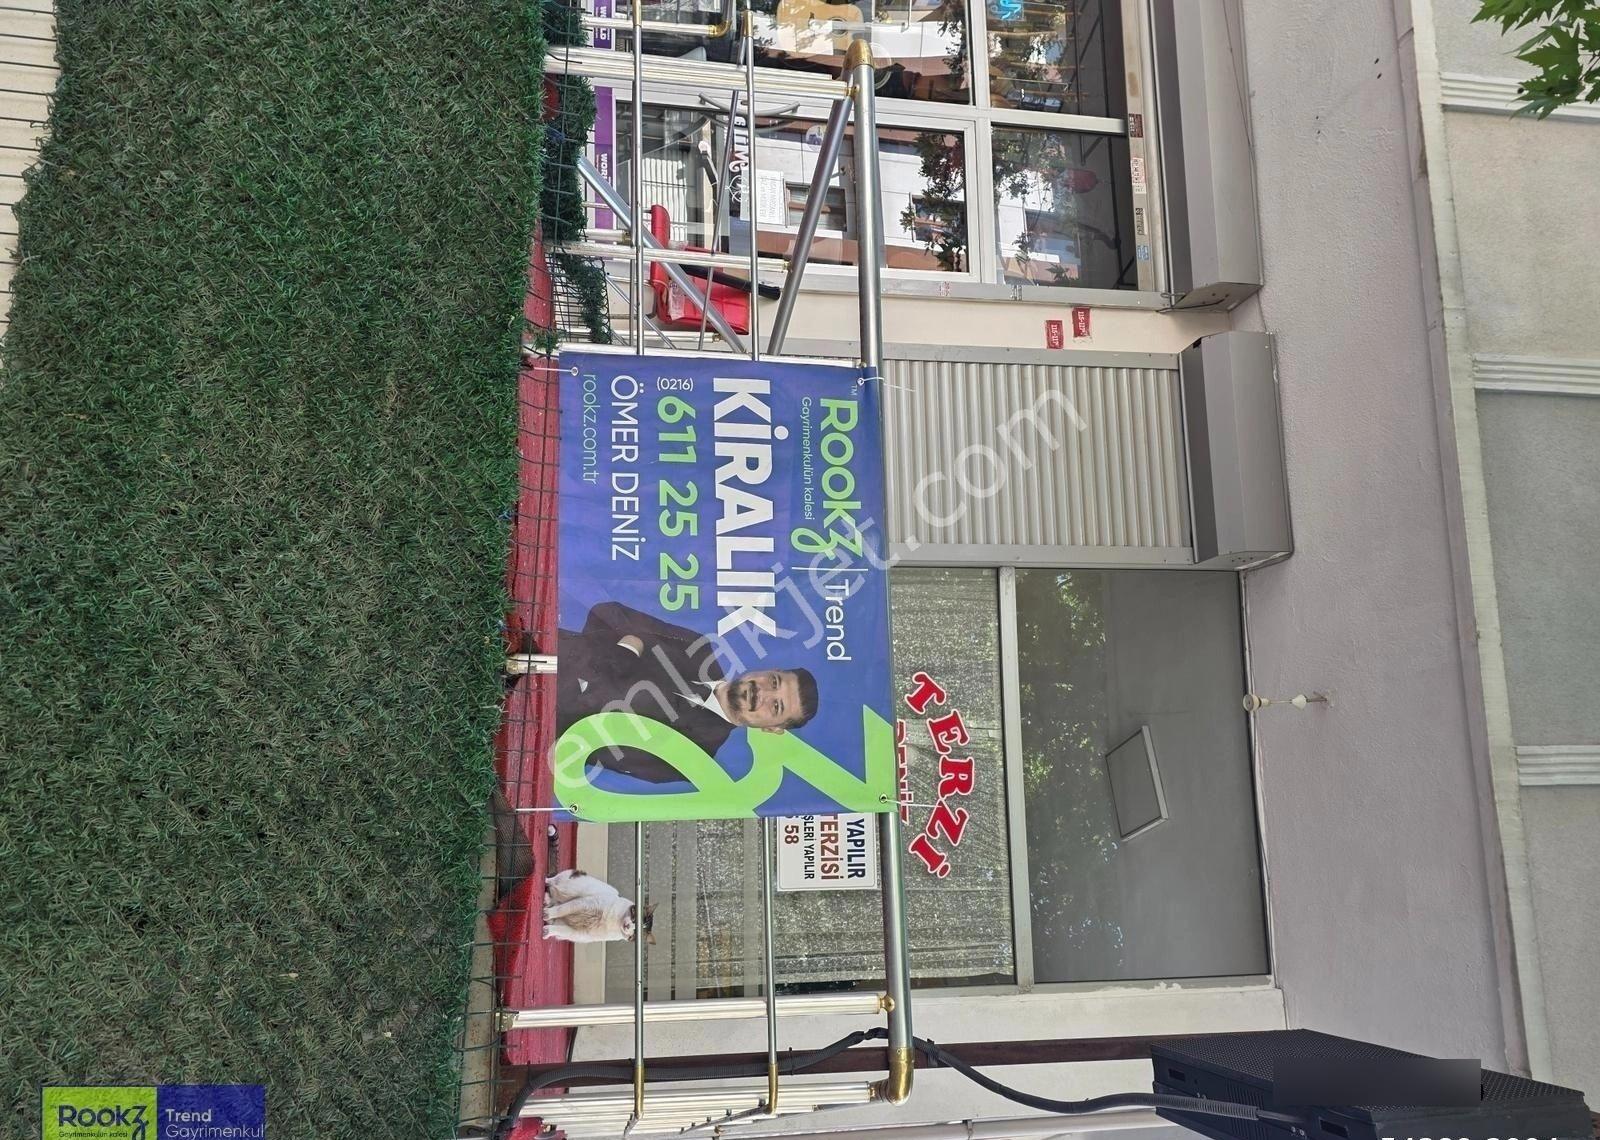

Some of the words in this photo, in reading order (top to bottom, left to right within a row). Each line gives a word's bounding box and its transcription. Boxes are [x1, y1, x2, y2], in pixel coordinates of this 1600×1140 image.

[610, 374, 644, 462] ÖMER
[656, 376, 694, 392] (0216)
[583, 374, 600, 484] rookz.com.tr
[657, 396, 696, 464] 611
[800, 396, 814, 484] Gayrimenkulün
[612, 472, 646, 560] DENİZ
[658, 479, 698, 537] 25
[713, 377, 789, 637] KİRALIK
[802, 487, 815, 520] kalesi
[659, 552, 699, 610] 25
[825, 578, 852, 661] Trend
[905, 672, 974, 878] TERZİ
[784, 824, 800, 844] 58
[804, 844, 815, 880] YAPILIR
[846, 818, 866, 878] YAPILIR
